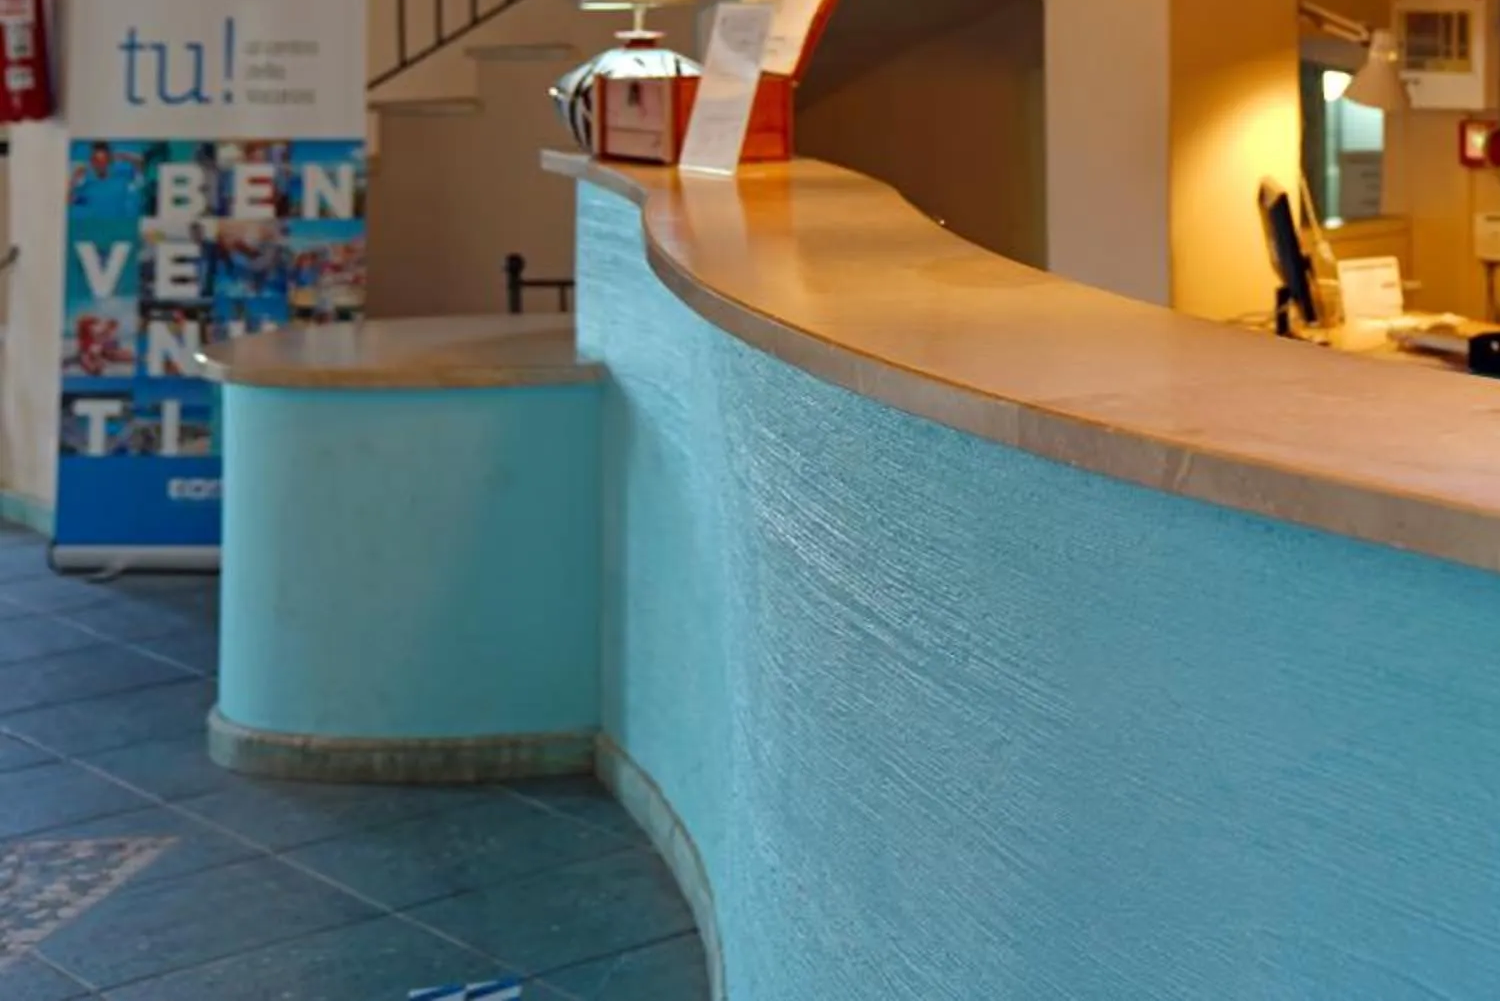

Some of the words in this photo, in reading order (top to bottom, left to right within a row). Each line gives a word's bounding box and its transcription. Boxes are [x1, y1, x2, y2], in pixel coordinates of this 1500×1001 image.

[117, 16, 236, 105] tu!
[157, 163, 354, 220] BEN
[75, 241, 199, 298] VE
[73, 399, 180, 456] TI
